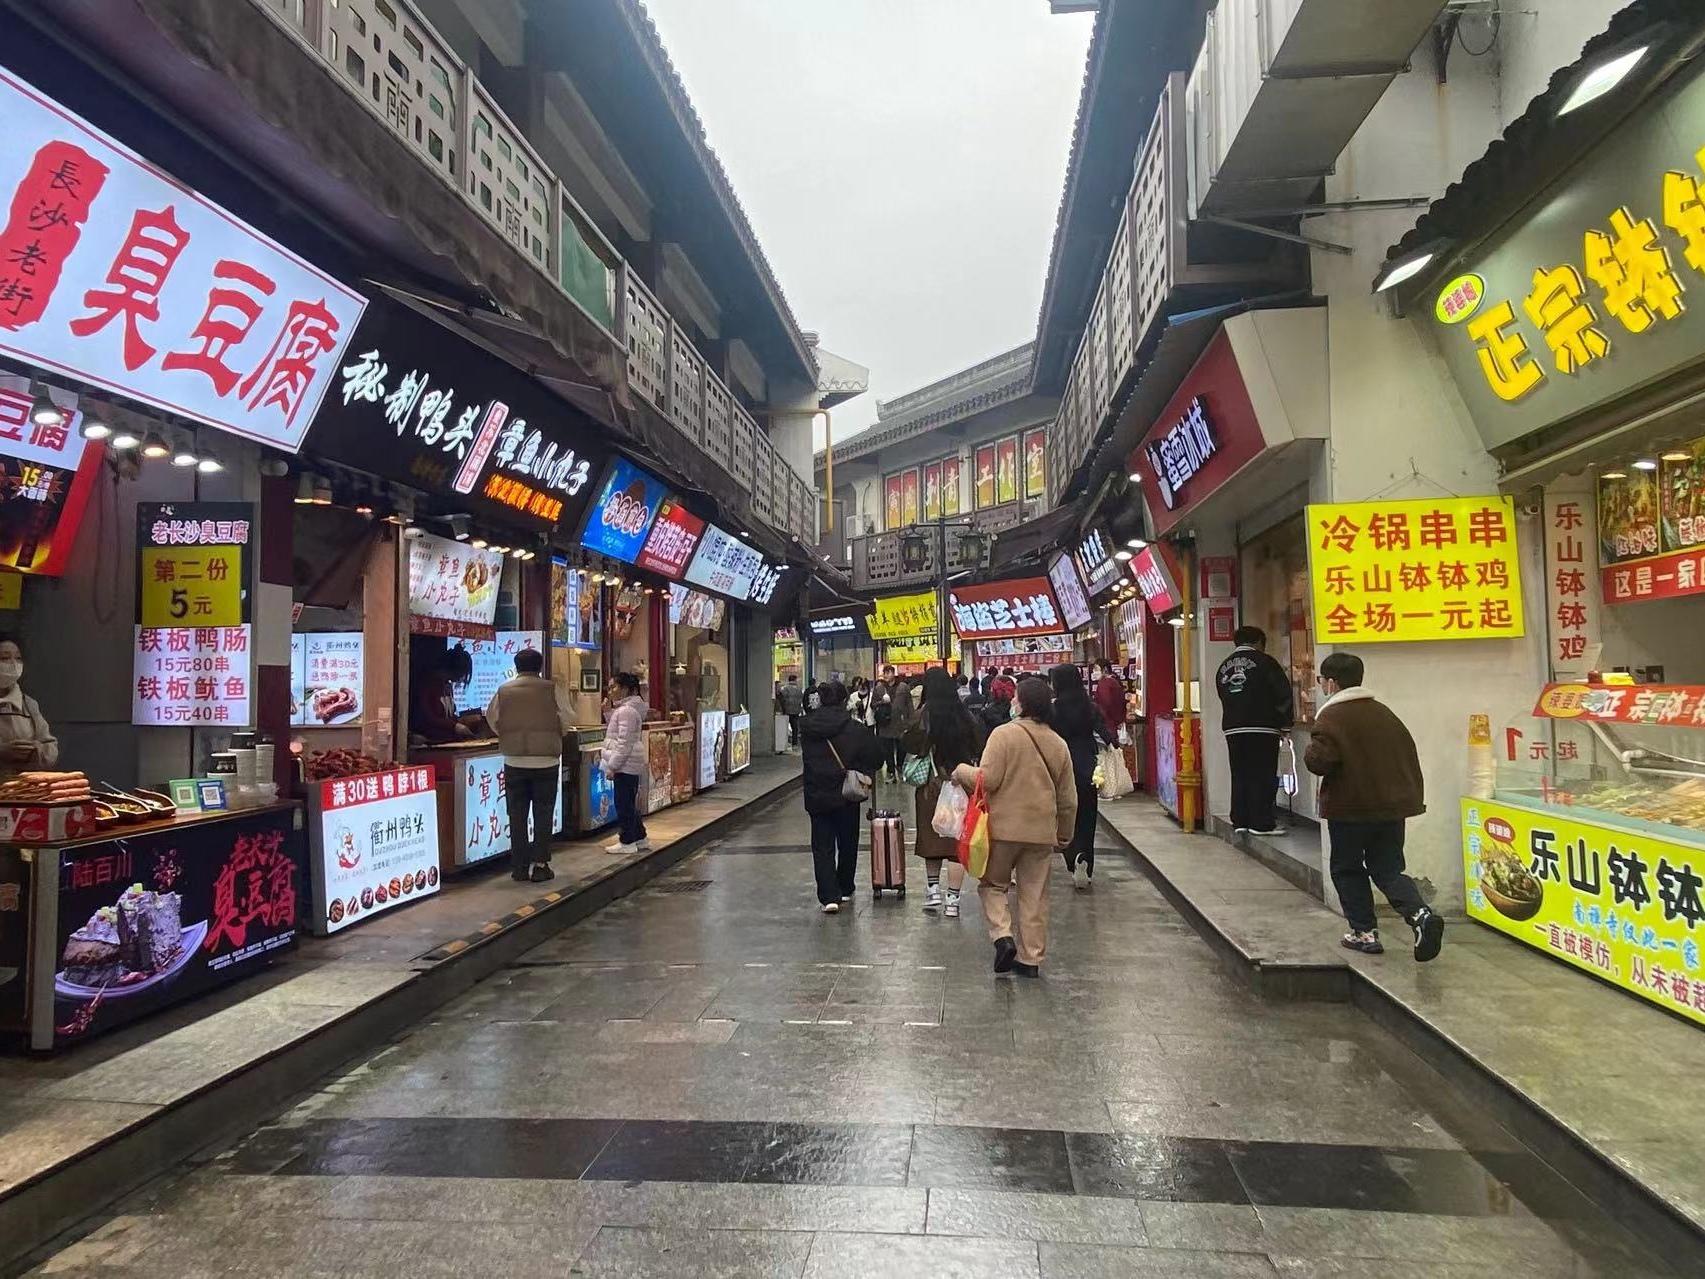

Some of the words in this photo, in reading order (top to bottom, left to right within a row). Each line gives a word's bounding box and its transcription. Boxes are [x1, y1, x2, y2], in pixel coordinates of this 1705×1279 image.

[70, 205, 341, 430] 臭豆腐
[495, 417, 590, 496] 章鱼小丸子
[1160, 396, 1217, 493] 蜜雪冰城
[152, 519, 250, 545] 老长沙臭豆腐
[1320, 507, 1508, 553] 冷锅串串
[154, 558, 229, 583] 第二份
[1325, 559, 1509, 596] 乐山钵钵鸡
[1556, 502, 1587, 661] 乐山钵钵鸡
[1615, 556, 1705, 599] 这是一家
[170, 589, 212, 619] 5元
[1325, 598, 1514, 635] 全场一元起
[139, 628, 247, 652] 铁板鸭肠
[155, 656, 229, 673] 15元80串
[138, 676, 247, 701] 铁板鱿鱼
[154, 704, 229, 722] 15元40串
[1530, 829, 1705, 930] 乐山钵钵
